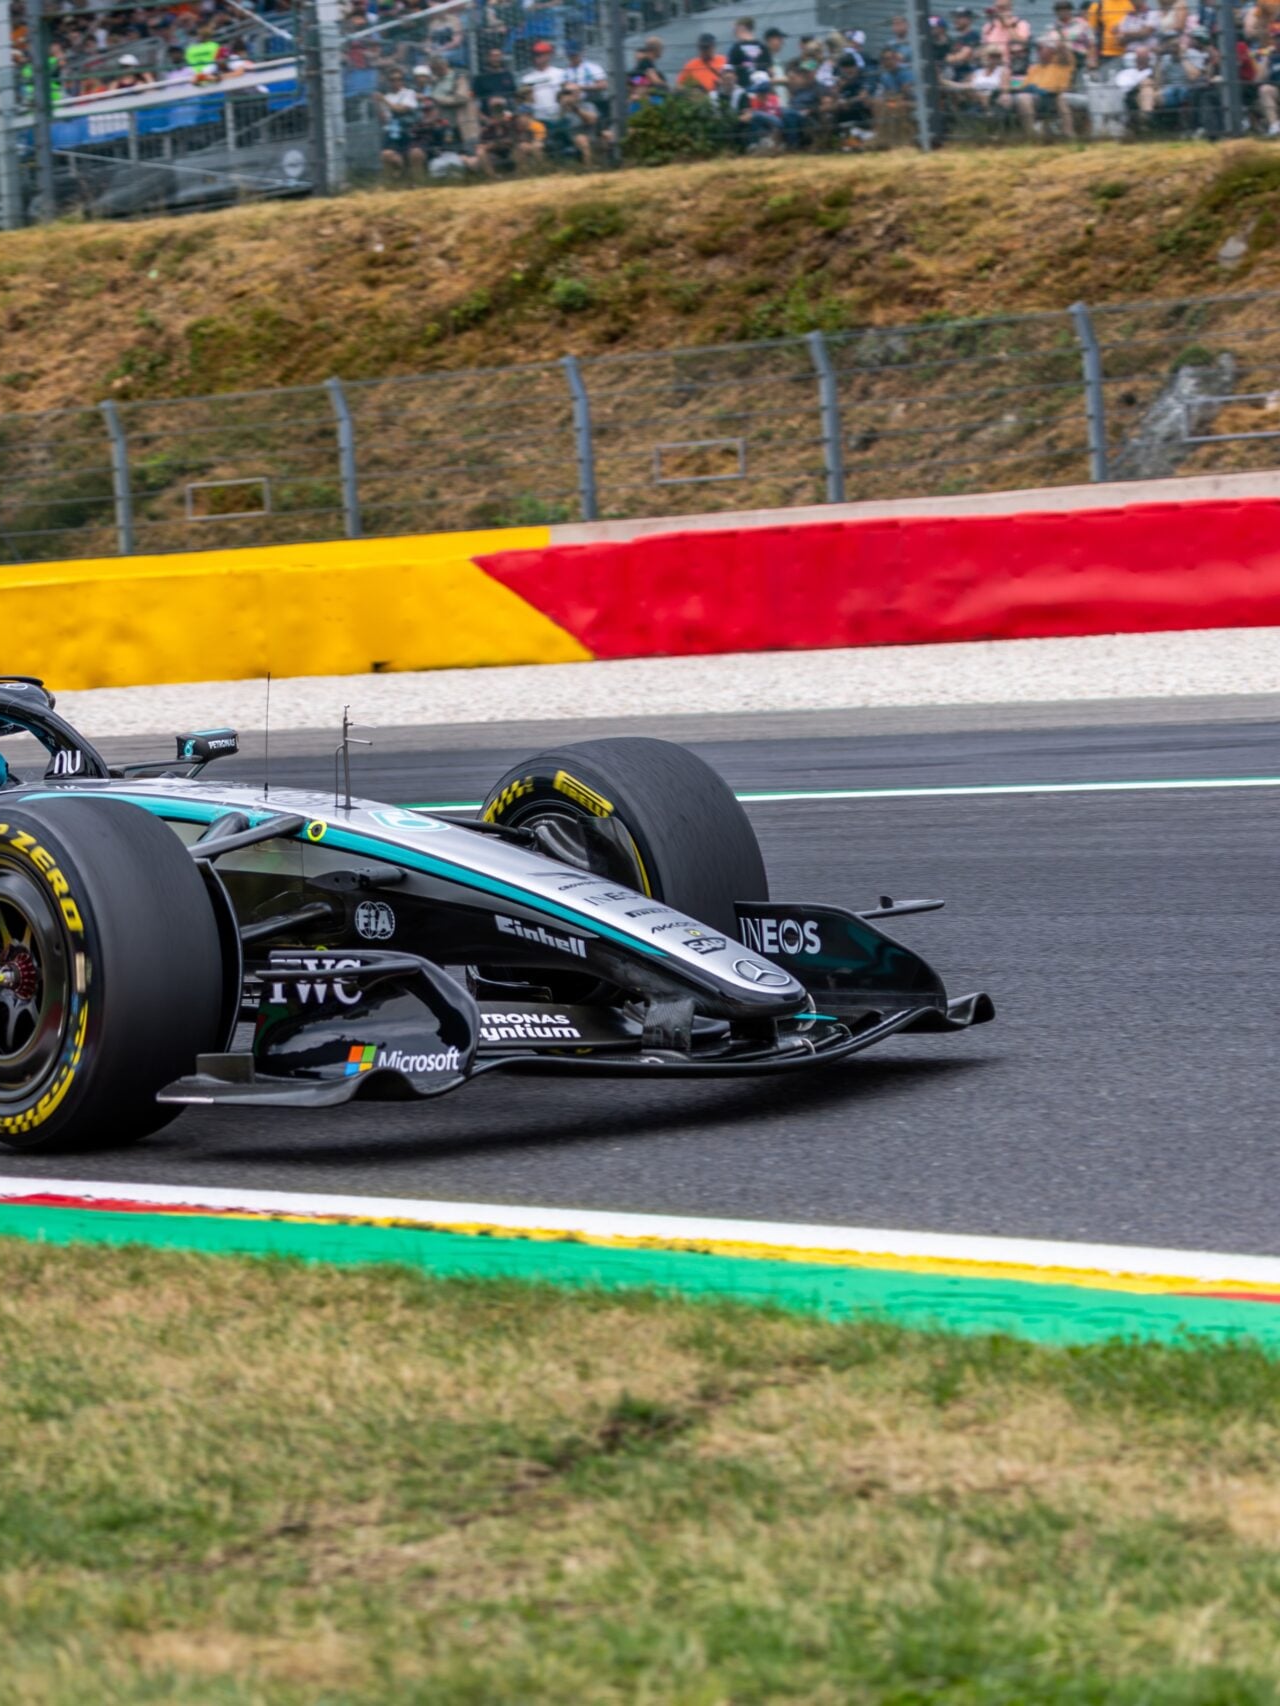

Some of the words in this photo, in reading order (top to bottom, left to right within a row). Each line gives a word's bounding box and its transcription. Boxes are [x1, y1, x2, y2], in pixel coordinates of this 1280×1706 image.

[10, 830, 84, 932] ZERO
[494, 914, 587, 958] Einhell
[686, 937, 726, 954] SAP
[738, 916, 821, 955] INEOS
[269, 958, 362, 1004] IWC
[378, 1046, 460, 1073] Microsoft
